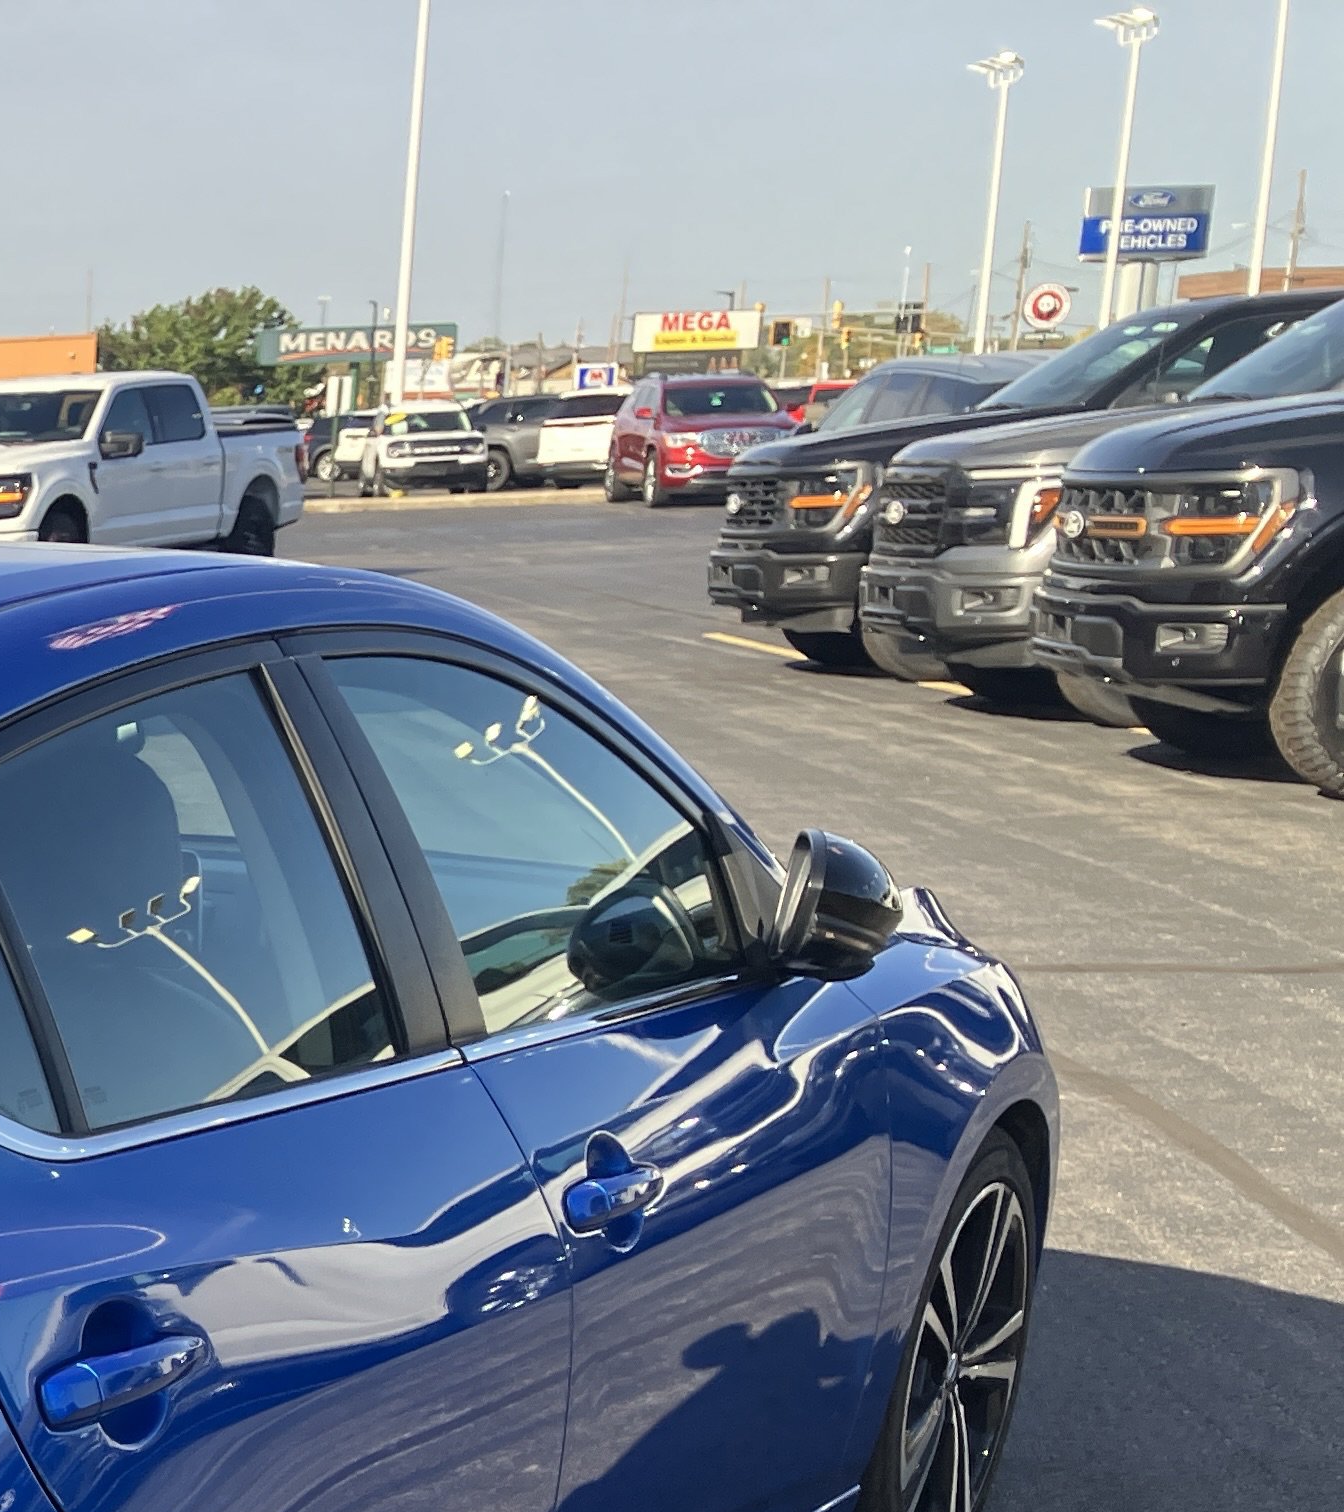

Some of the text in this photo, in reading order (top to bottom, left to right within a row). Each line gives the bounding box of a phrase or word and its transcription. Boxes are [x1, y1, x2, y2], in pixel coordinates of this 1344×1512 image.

[1099, 217, 1199, 235] PE-OWNED
[1117, 234, 1188, 250] EHICLES
[660, 311, 732, 332] MEGA
